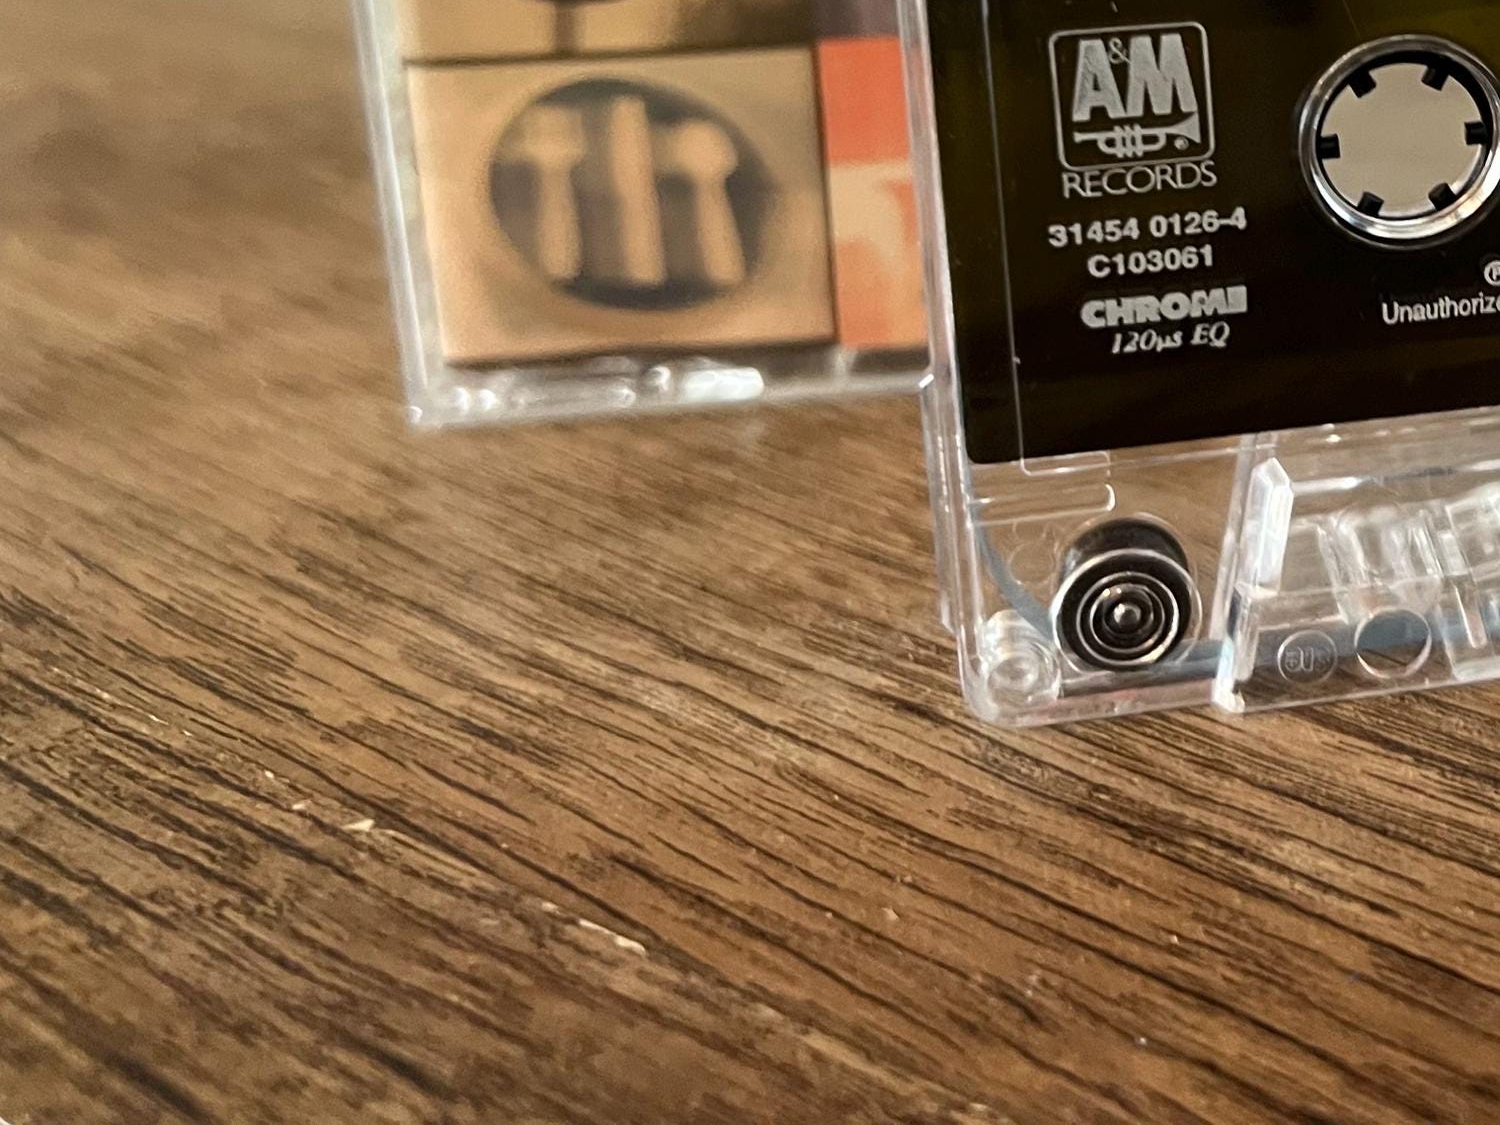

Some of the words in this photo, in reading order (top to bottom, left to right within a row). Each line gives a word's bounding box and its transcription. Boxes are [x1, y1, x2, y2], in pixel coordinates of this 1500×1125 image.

[1073, 33, 1198, 121] A&M
[1062, 161, 1217, 198] RECORDS
[1048, 218, 1140, 247] 31454
[1150, 206, 1247, 237] 0126-4
[1088, 244, 1213, 276] C103061
[1191, 321, 1231, 348] EQ
